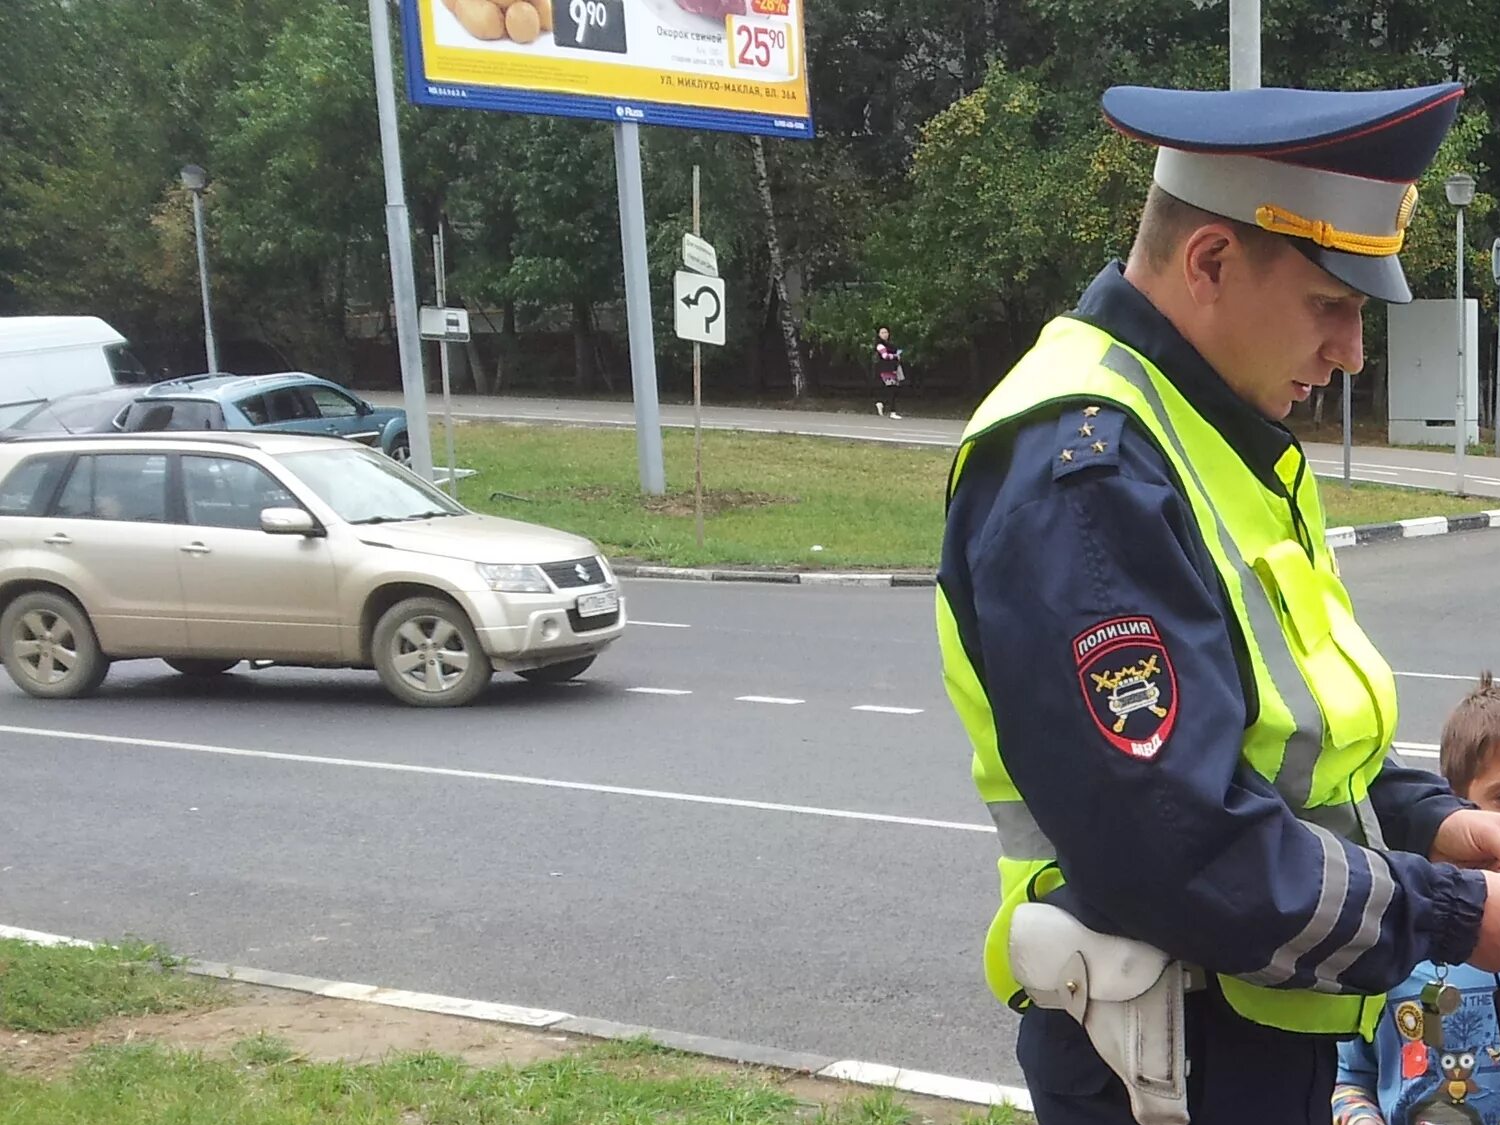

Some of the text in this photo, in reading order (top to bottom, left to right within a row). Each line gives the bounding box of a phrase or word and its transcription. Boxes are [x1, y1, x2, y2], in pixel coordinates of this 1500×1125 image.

[656, 25, 723, 44] Окорок свиной
[660, 75, 674, 86] УЛ.
[677, 77, 763, 97] МИКЛУХО-МАКЛАЯ,
[1077, 621, 1152, 656] ПОЛИЦИЯ
[1130, 733, 1163, 758] МВД
[1468, 994, 1493, 1006] THE
